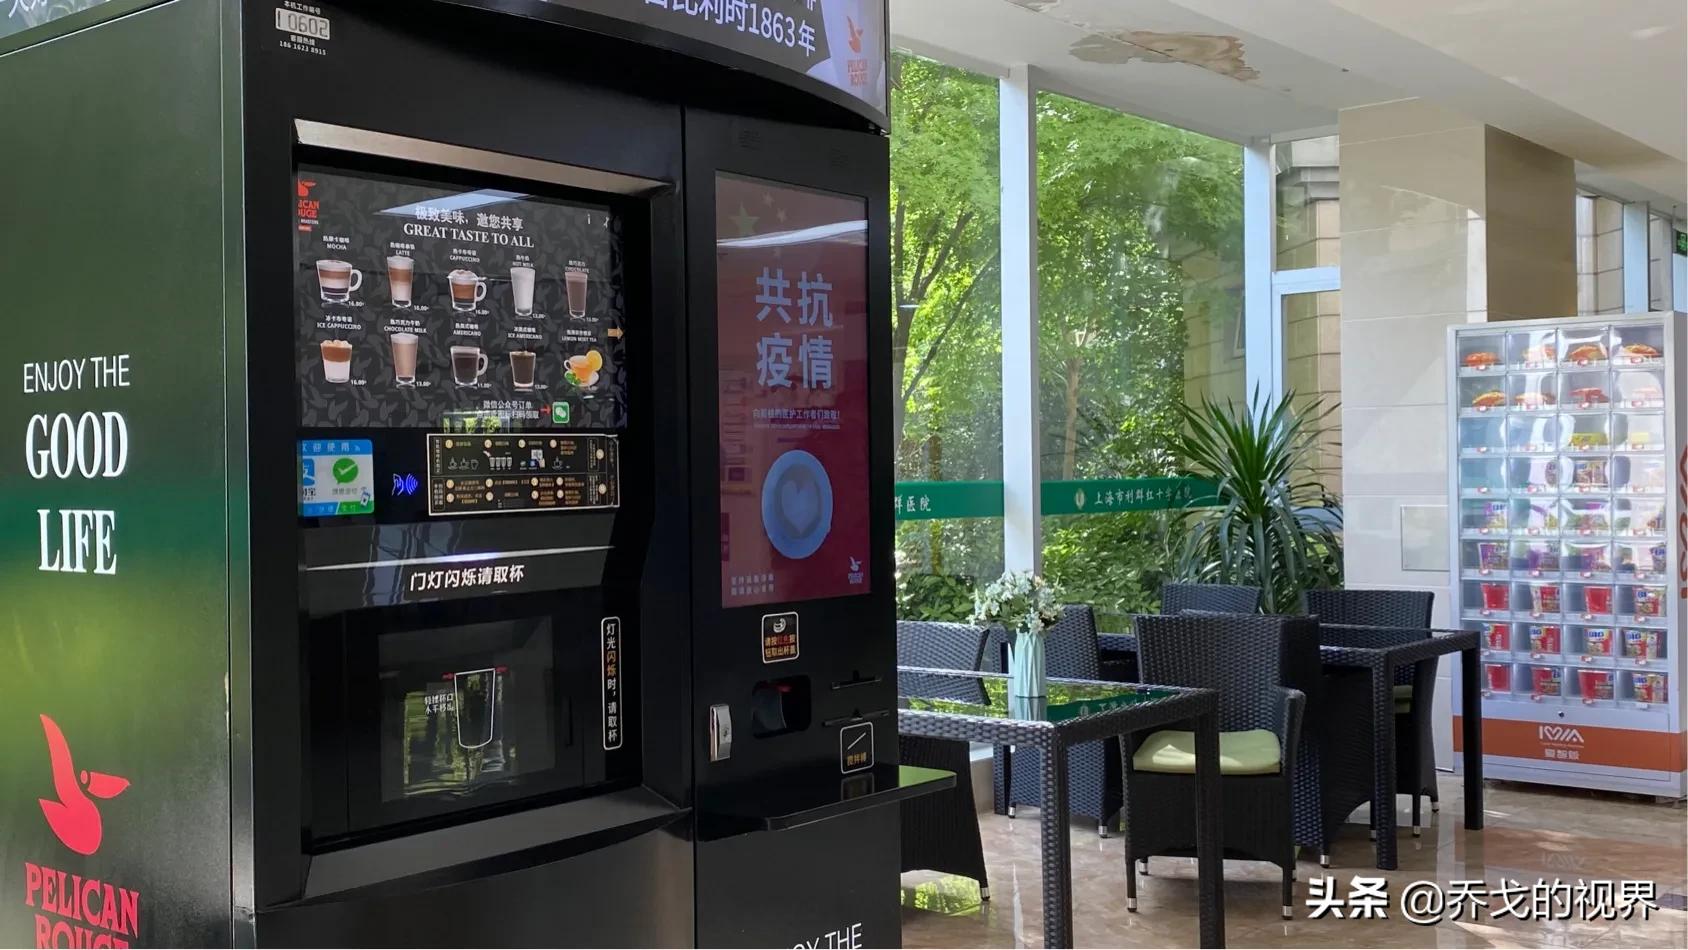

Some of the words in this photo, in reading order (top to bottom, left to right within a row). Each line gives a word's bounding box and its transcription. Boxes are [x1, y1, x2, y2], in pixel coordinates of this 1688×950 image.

[403, 222, 448, 239] GREAT
[450, 228, 490, 244] TASTE
[493, 231, 509, 246] TO
[511, 235, 535, 248] ALL
[449, 254, 480, 262] CAPPUCCINO
[755, 266, 833, 328] 共抗
[23, 358, 86, 393] ENJOY
[90, 354, 130, 388] THE
[756, 332, 834, 390] 疫情
[25, 411, 128, 479] GOOD
[37, 509, 117, 575] LIFE
[410, 564, 525, 591] 门灯闪烁请取杯
[25, 862, 140, 939] PELICAN
